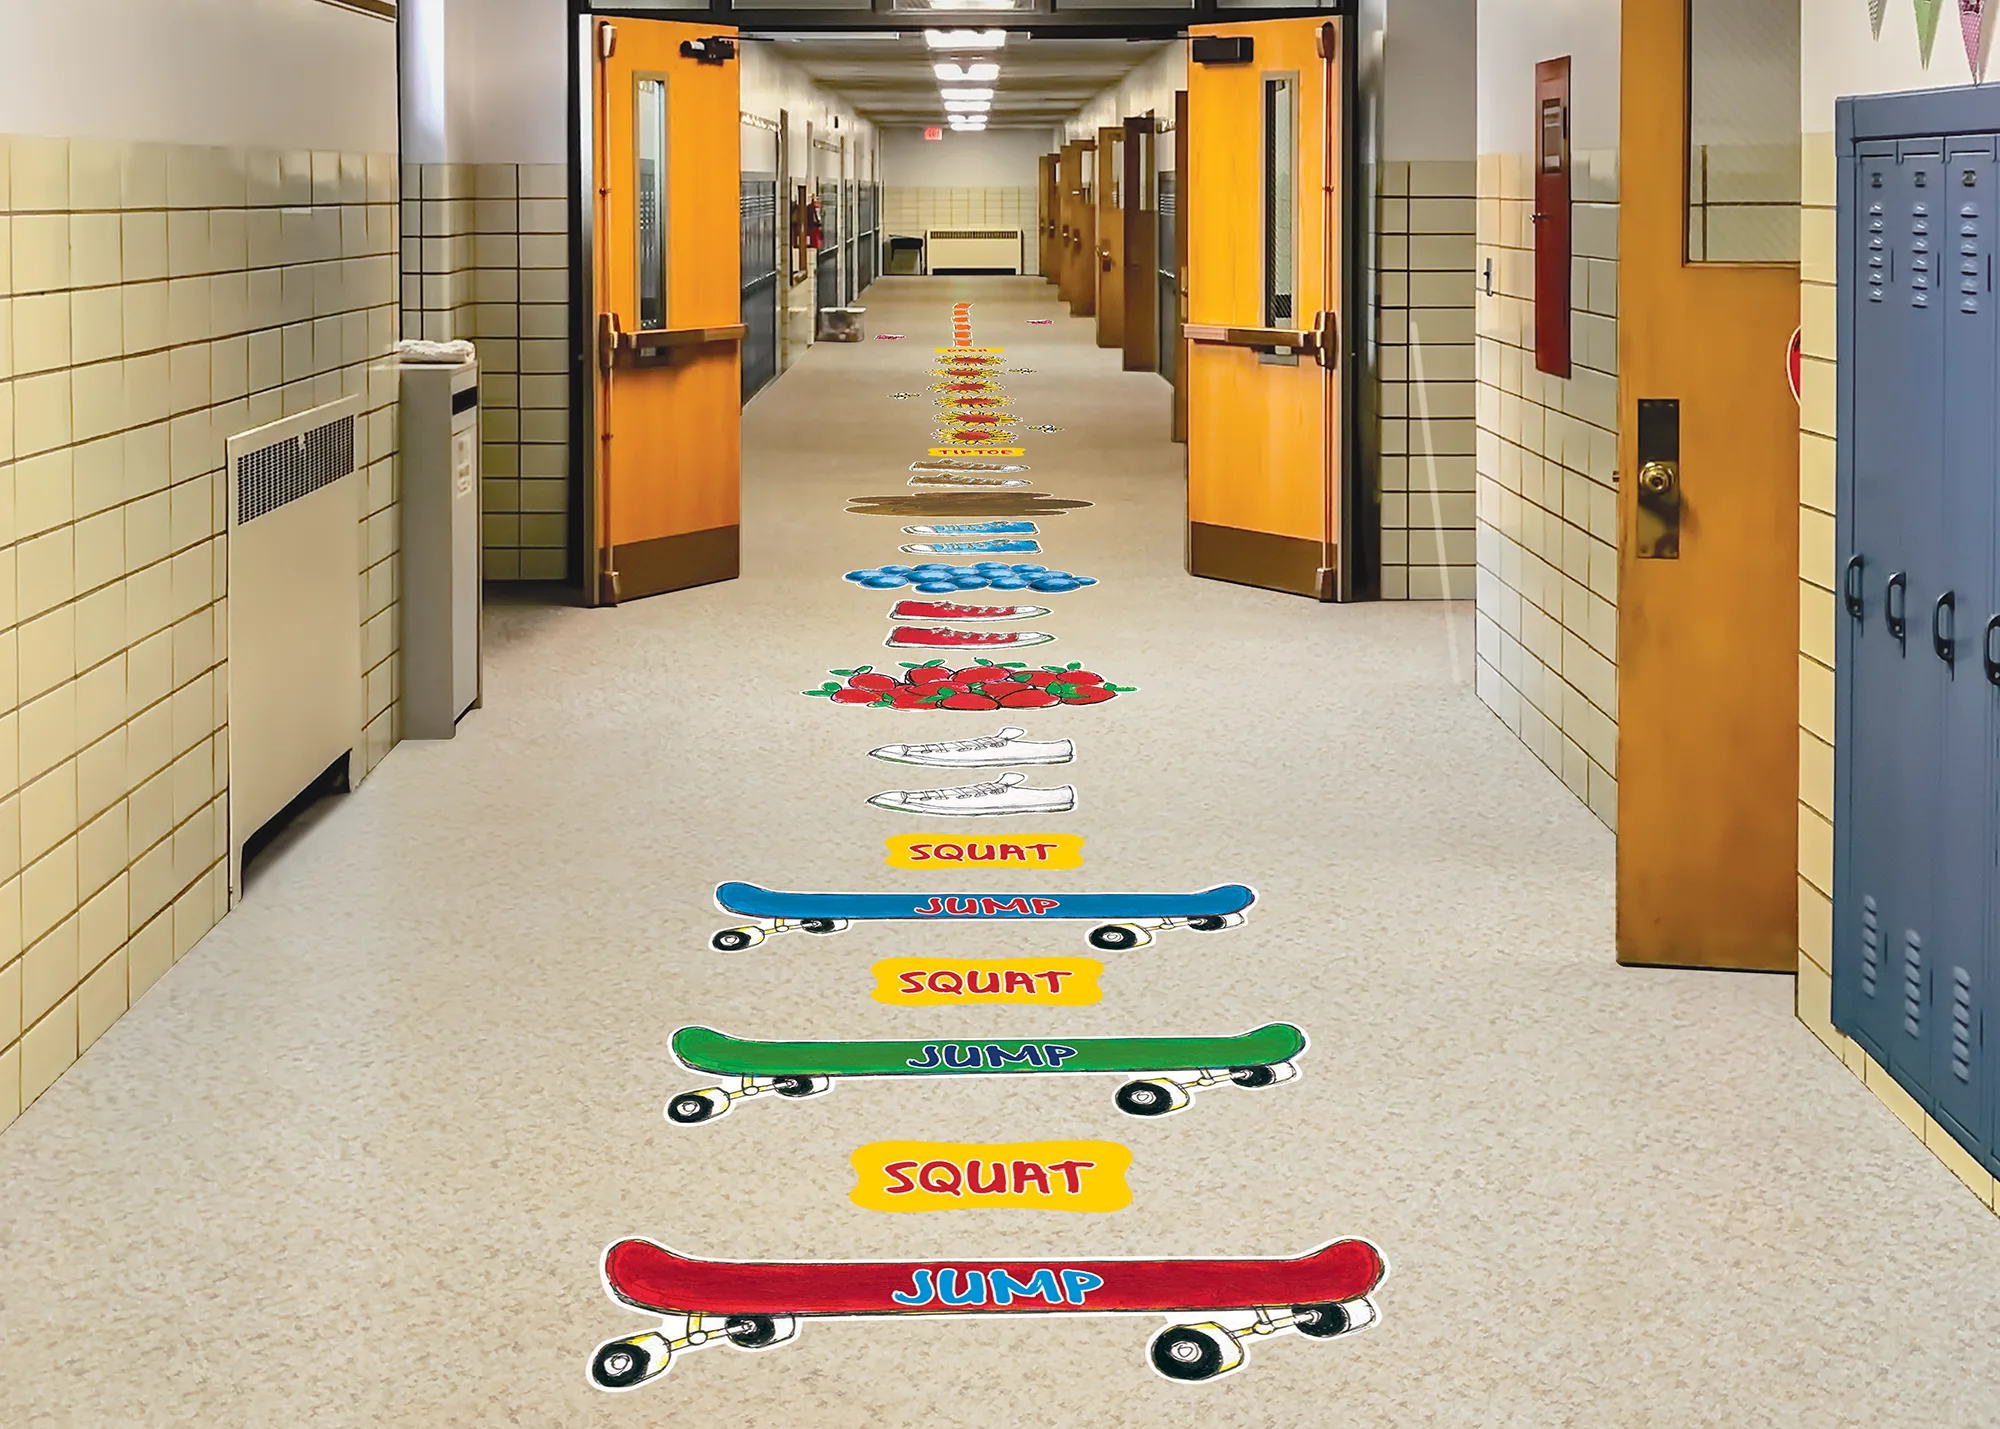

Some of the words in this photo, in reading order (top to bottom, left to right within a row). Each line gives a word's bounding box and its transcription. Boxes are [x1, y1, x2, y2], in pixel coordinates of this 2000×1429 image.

[909, 843, 1059, 862] SQUAT
[914, 897, 1060, 915] JUMP
[898, 970, 1073, 996] SQUAT
[906, 1044, 1078, 1068] JUMP
[884, 1160, 1097, 1197] SQUAT
[892, 1268, 1104, 1306] JUMP
